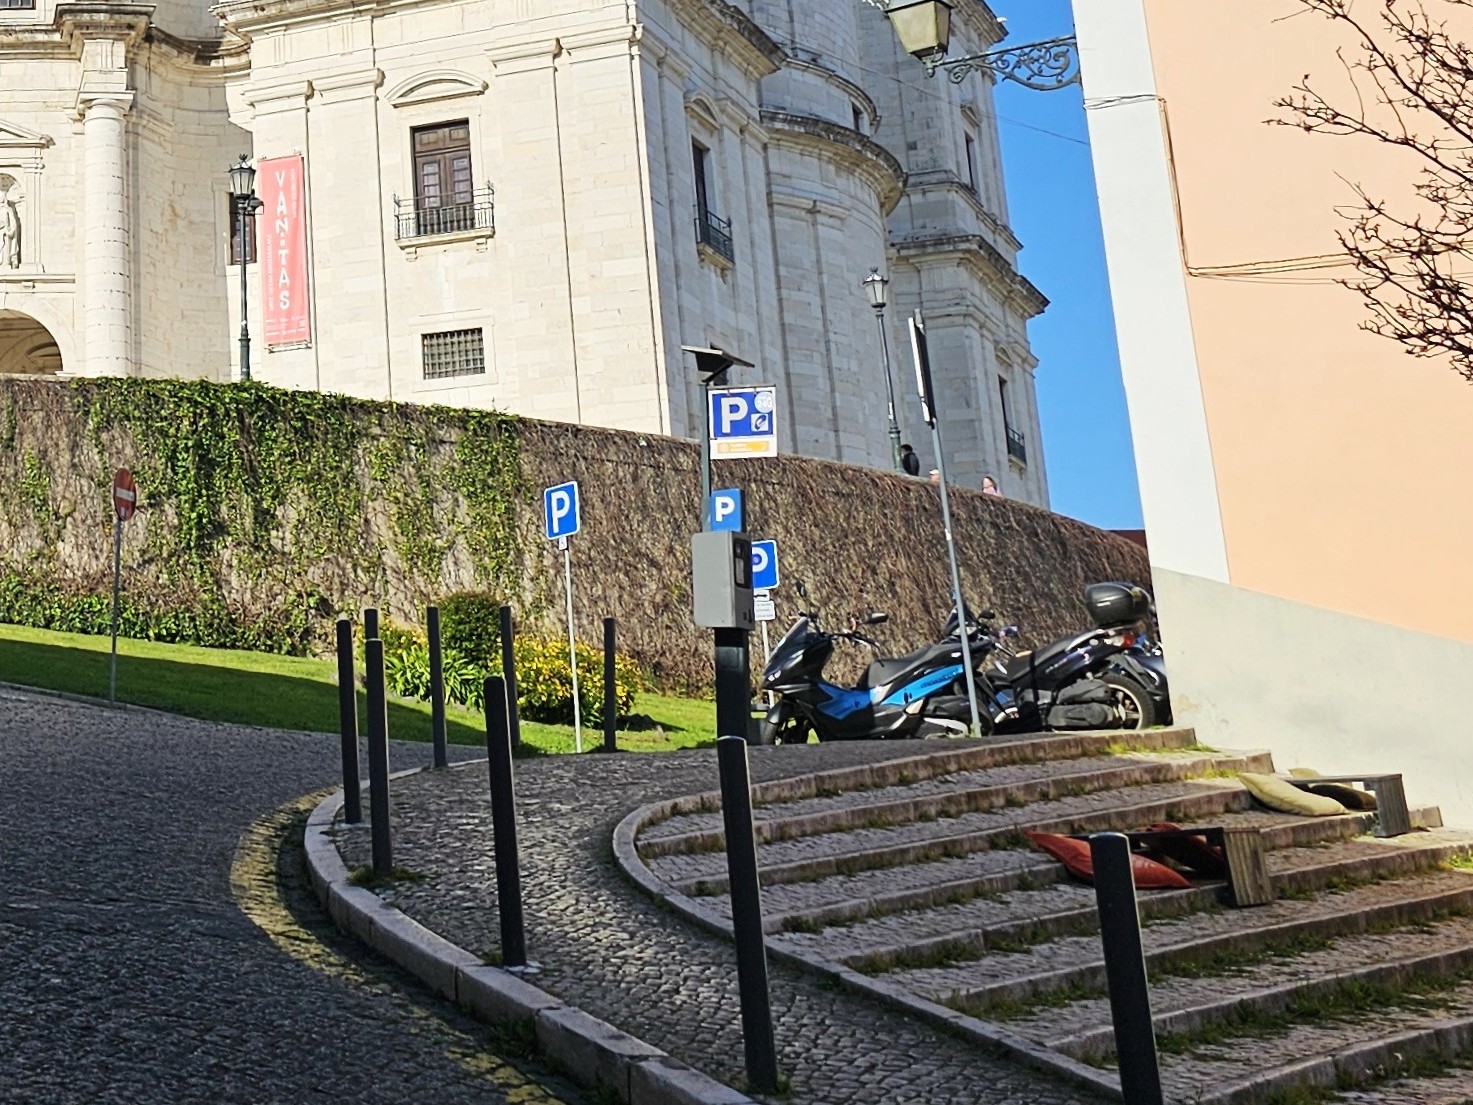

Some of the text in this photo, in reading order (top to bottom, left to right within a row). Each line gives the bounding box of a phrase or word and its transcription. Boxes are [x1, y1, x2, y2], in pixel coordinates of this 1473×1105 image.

[274, 169, 290, 311] VANITAS
[721, 397, 748, 433] P
[551, 490, 570, 533] P
[715, 496, 735, 521] P
